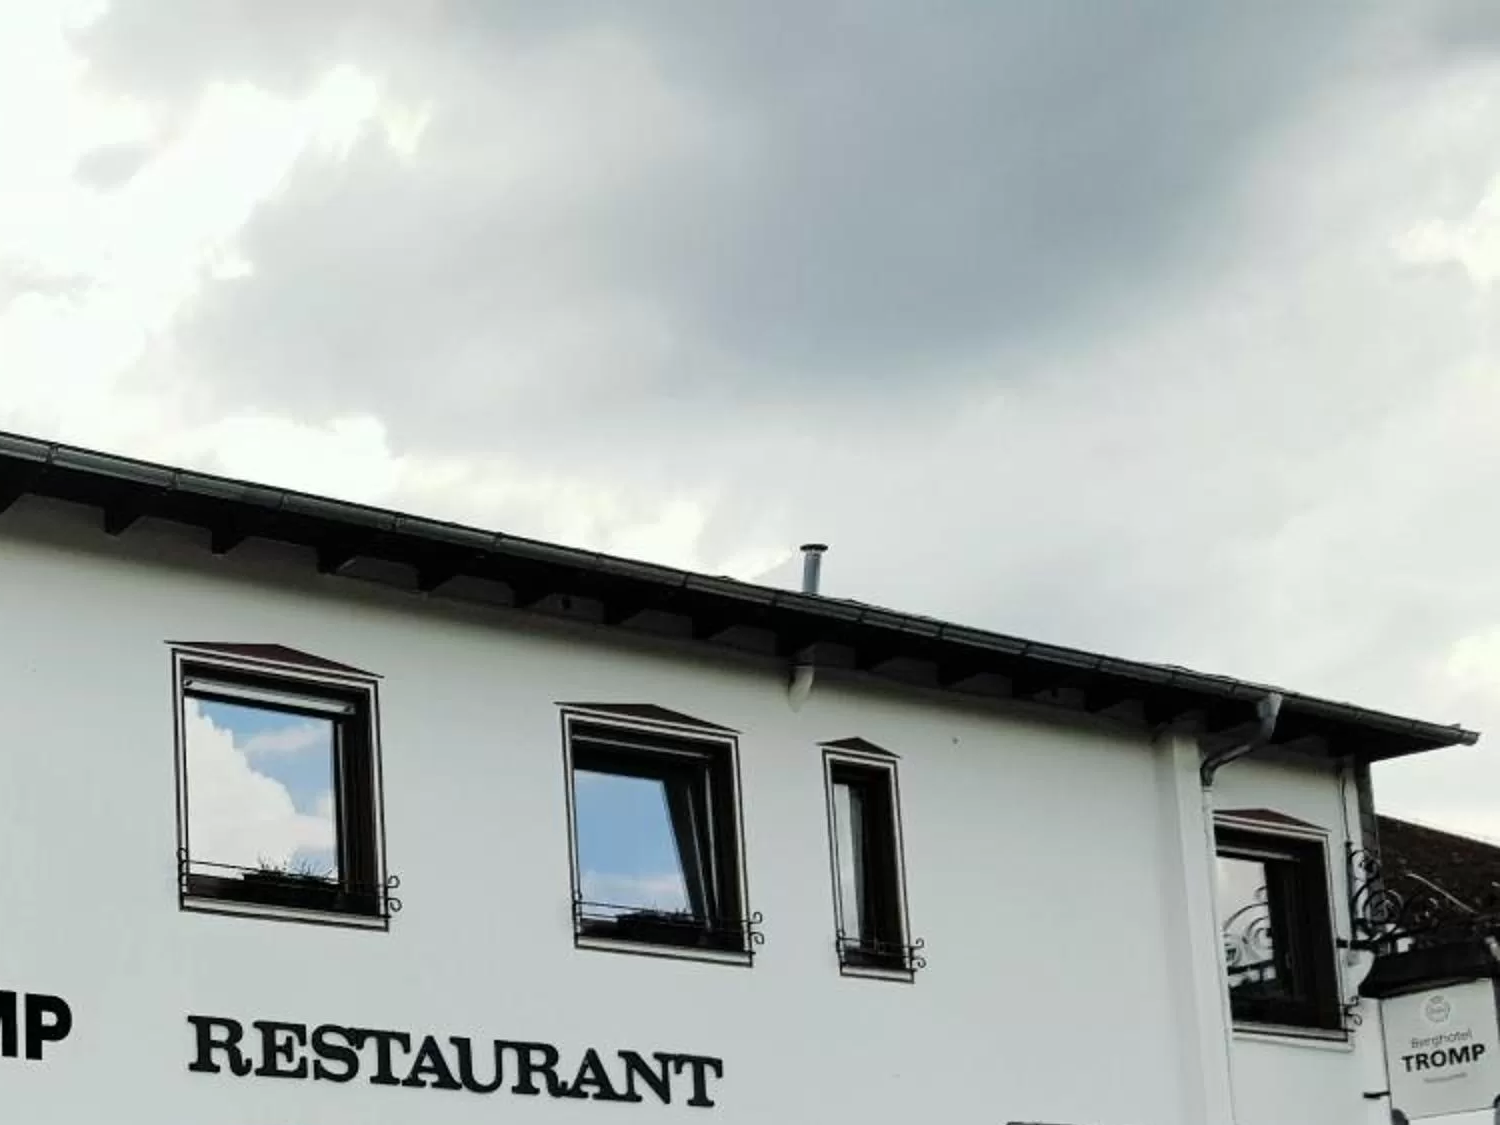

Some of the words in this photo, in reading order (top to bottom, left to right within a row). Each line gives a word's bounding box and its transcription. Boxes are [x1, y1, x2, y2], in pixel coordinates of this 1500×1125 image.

[1411, 1028, 1473, 1048] Berghotel
[187, 1014, 723, 1108] RESTAURANT
[1401, 1044, 1485, 1072] TROMP
